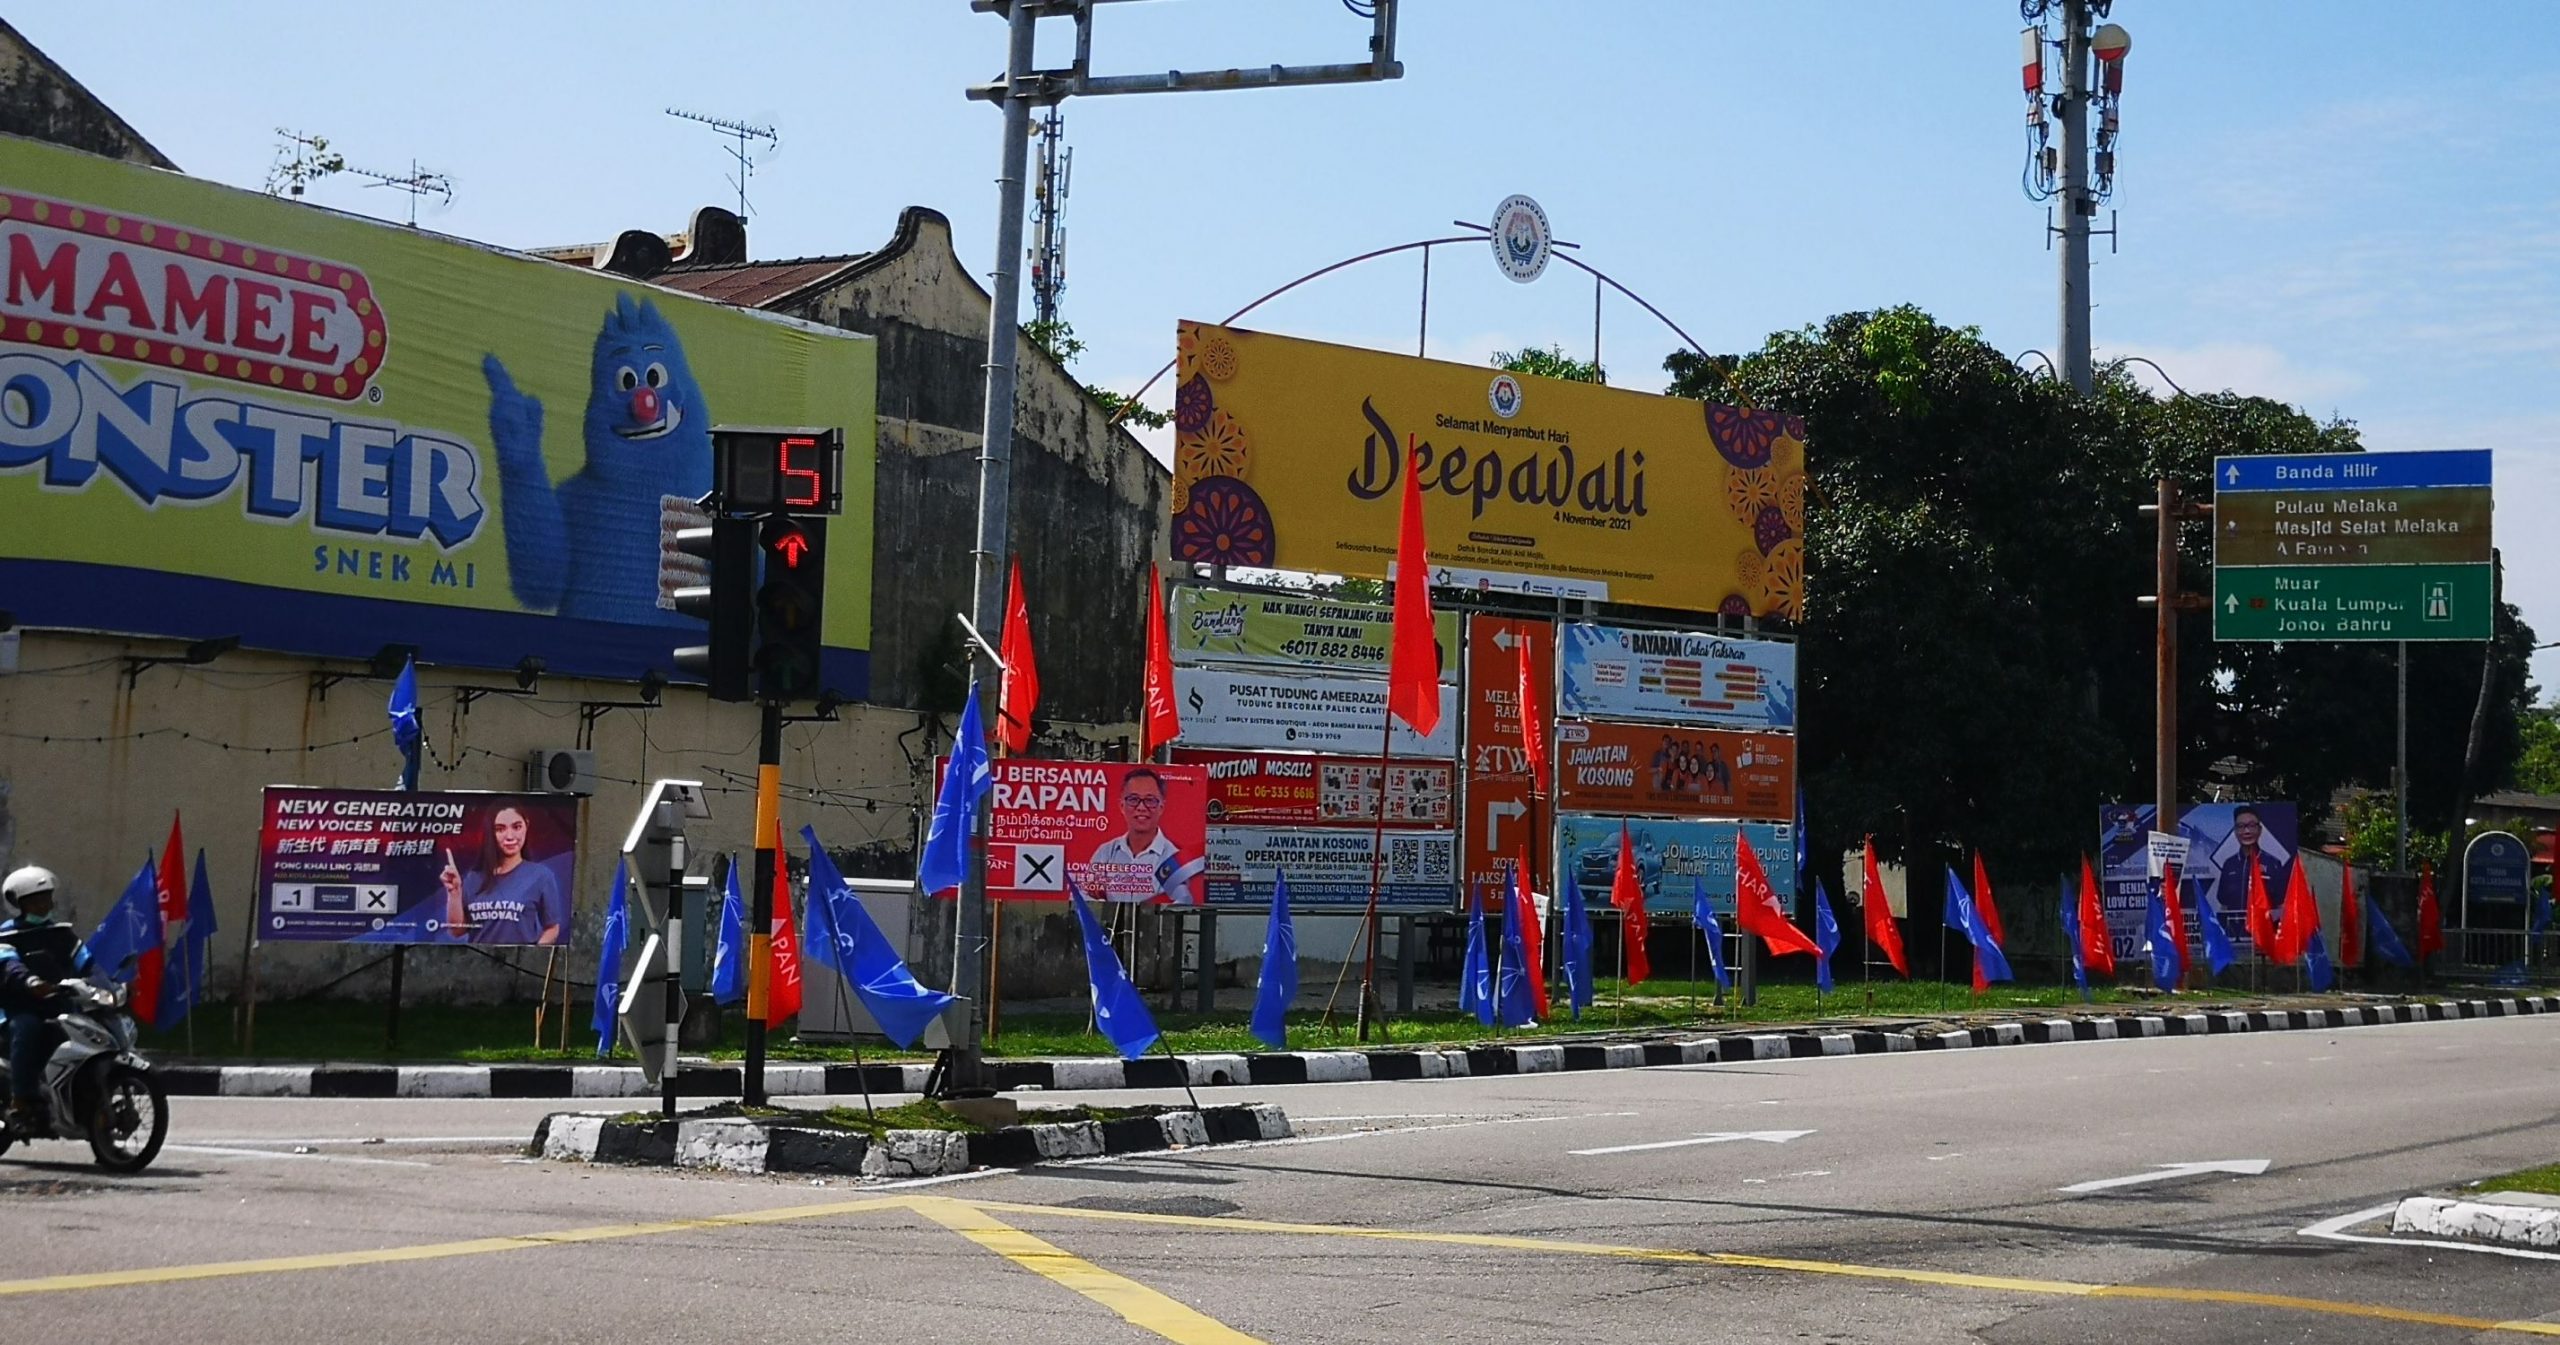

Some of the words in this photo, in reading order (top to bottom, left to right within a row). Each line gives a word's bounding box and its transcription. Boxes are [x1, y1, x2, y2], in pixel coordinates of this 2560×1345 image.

[8, 233, 340, 366] MAMEE
[1435, 413, 1480, 433] Selamat
[1483, 419, 1546, 442] Menyambut
[1548, 428, 1569, 444] Hari
[1347, 394, 1648, 521] Deepavali
[780, 438, 820, 505] 5
[2275, 464, 2334, 479] Banda
[2343, 464, 2378, 478] Hilir
[2275, 499, 2325, 514] Pulau
[2333, 499, 2398, 513] Melaka
[1553, 512, 1561, 523] 4
[1562, 513, 1607, 529] November
[1609, 517, 1631, 531] 2021
[2275, 520, 2332, 537] Masjid
[2340, 520, 2387, 535] Selat
[2395, 518, 2460, 533] Melaka
[2277, 543, 2288, 556] A
[315, 545, 409, 581] SNEK
[430, 561, 475, 588] MI
[1450, 554, 1476, 564] Jabatan
[1490, 557, 1513, 566] Seluruh
[1515, 561, 1533, 570] warga
[1534, 562, 1550, 571] kerja
[1551, 563, 1568, 573] Majlis
[1568, 565, 1601, 576] Bandaraya
[1602, 569, 1624, 578] Melaka
[1625, 571, 1655, 581] Bersejarah
[2275, 577, 2321, 590] Muar
[1262, 602, 1283, 615] NAK
[1285, 603, 1318, 618] WANGI
[1320, 608, 1374, 623] SEPANJANG
[2275, 597, 2328, 612] Kuala
[1191, 608, 1244, 637] Bandung
[1303, 623, 1335, 638] TANYA
[1336, 625, 1362, 640] KAMI
[1280, 640, 1318, 656] +6017
[1320, 644, 1348, 659] 882
[1351, 645, 1385, 662] 8446
[1632, 634, 1683, 657] BAYARAN
[1684, 638, 1709, 658] Cukai
[1709, 640, 1746, 660] Taksiran
[1229, 684, 1268, 698] PUSAT
[1271, 686, 1318, 701] TUDUNG
[1237, 699, 1274, 709] TUDUNG
[1276, 701, 1325, 712] BERCORAK
[1326, 704, 1356, 714] PALING
[1495, 705, 1521, 718] RAYA
[1250, 717, 1274, 725] SISTERS
[1275, 718, 1307, 727] BOUTIQUE
[1567, 745, 1628, 766] JAWATAN
[1008, 766, 1108, 785] BERSAMA
[1189, 758, 1258, 779] MOTION
[1577, 766, 1634, 788] KOSONG
[1254, 785, 1290, 798] 06-335
[277, 800, 330, 815] NEW
[333, 800, 465, 819] GENERATION
[277, 819, 316, 831] NEW
[318, 820, 373, 832] VOICES
[380, 821, 418, 833] NEW
[420, 823, 463, 835] HOPE
[277, 837, 327, 854] 新生代
[330, 838, 380, 855] 新声音
[385, 839, 435, 857] 新希望
[1266, 836, 1319, 849] JAWATAN
[1322, 838, 1369, 850] KOSONG
[1245, 850, 1306, 862] OPERATOR
[1308, 851, 1388, 864] PENGELUARN
[1663, 845, 1690, 859] JOM
[1692, 846, 1728, 860] BALIK
[274, 862, 301, 870] FONG
[303, 862, 328, 870] KHAI
[330, 863, 352, 871] LING
[1067, 862, 1090, 871] LOW
[1091, 863, 1117, 872] CHEE
[1119, 864, 1153, 873] LEONG
[1673, 861, 1709, 877] JIMAT
[1712, 861, 1731, 877] RM
[1242, 884, 1257, 893] SILA
[2107, 895, 2127, 909] LOW
[2112, 937, 2135, 959] 02
